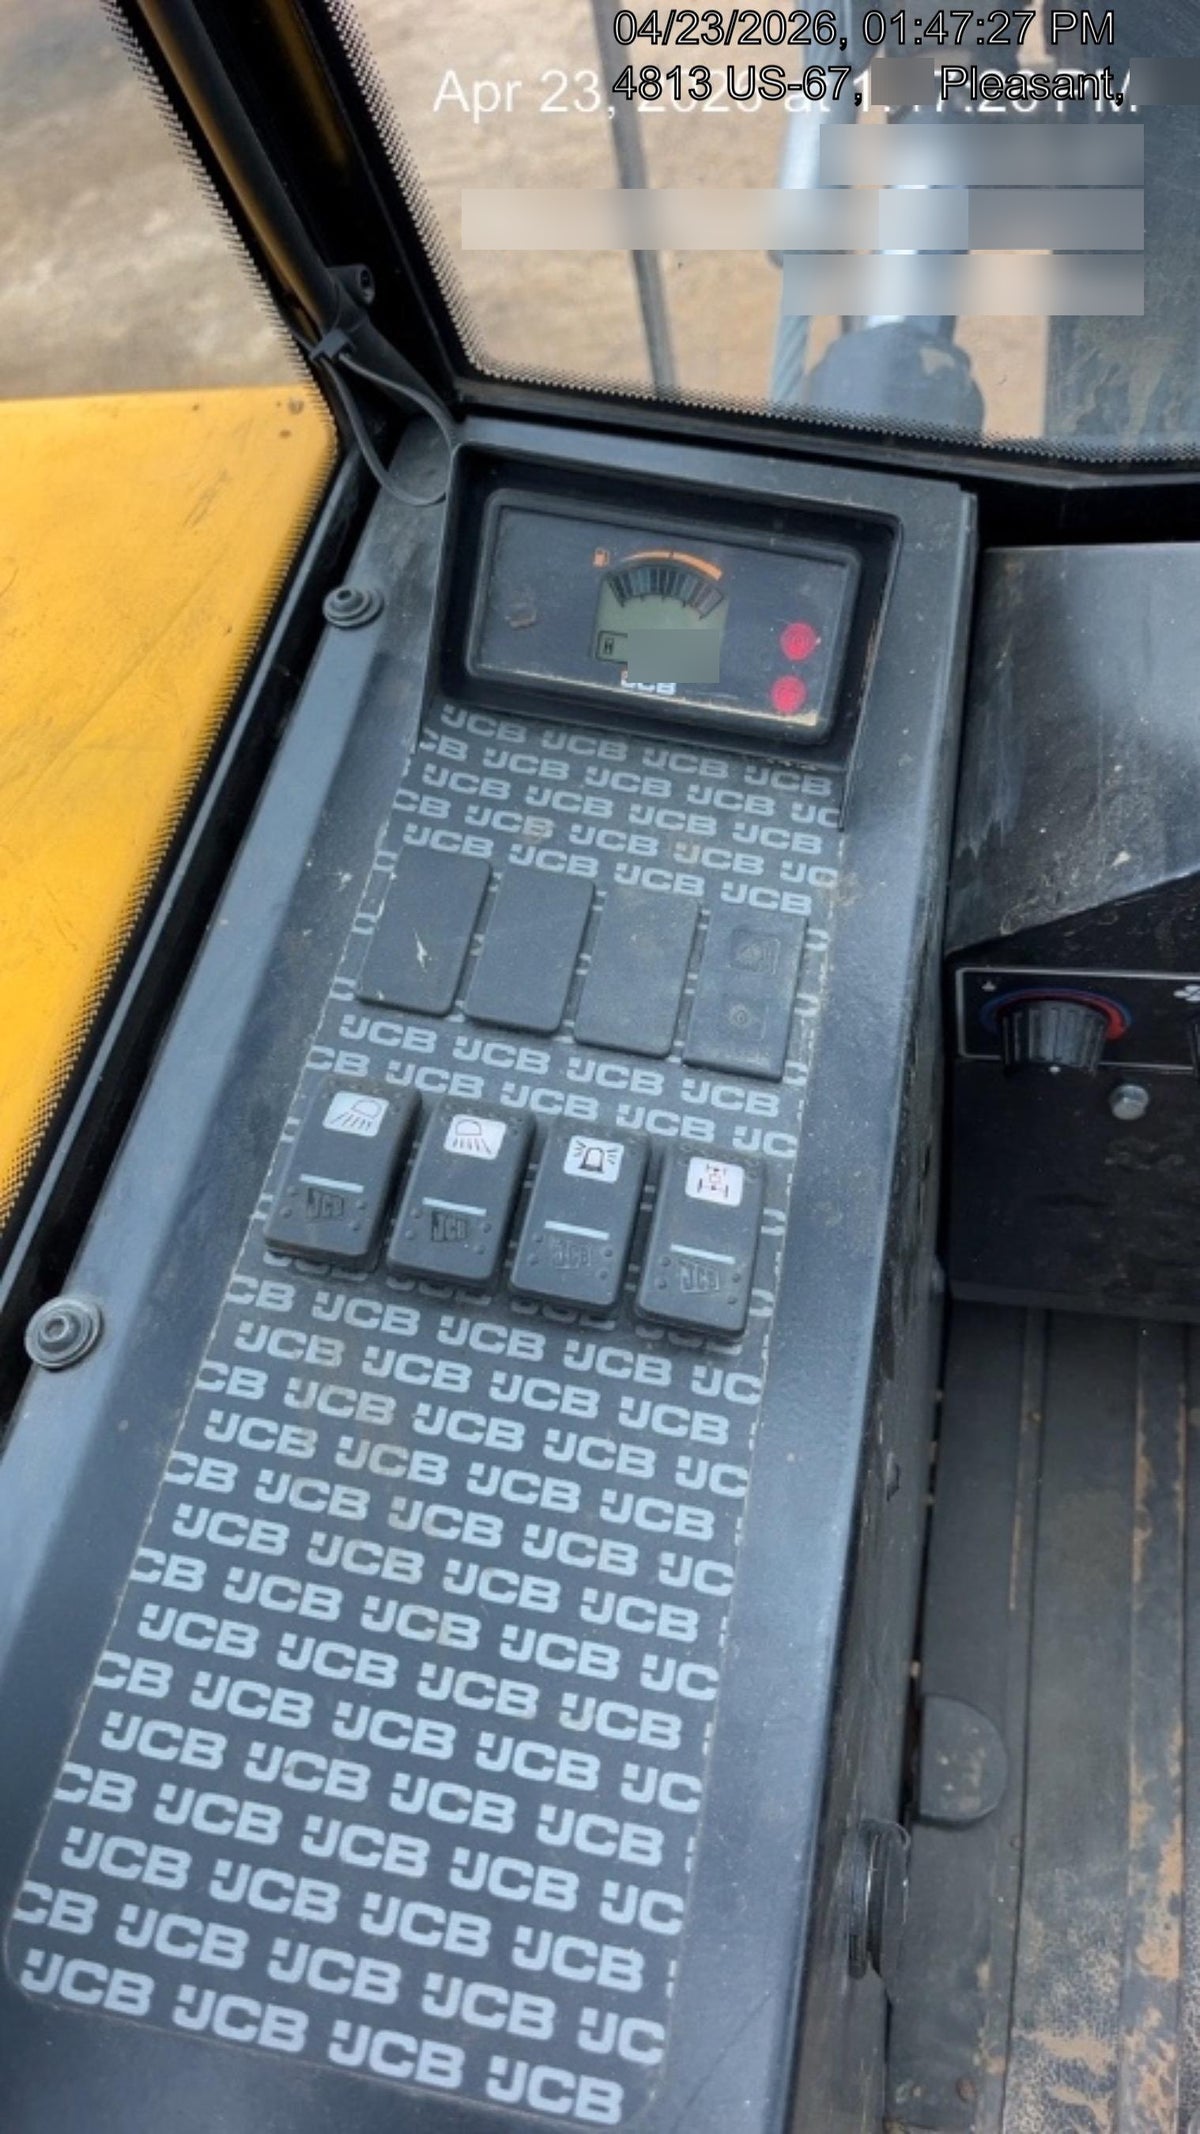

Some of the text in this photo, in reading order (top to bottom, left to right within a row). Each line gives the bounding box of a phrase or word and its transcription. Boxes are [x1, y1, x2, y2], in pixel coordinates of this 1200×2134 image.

[420, 731, 839, 827] CB JCB JCB JCB JC
[423, 764, 822, 854] JCB JCB JCB JCB
[441, 704, 832, 797] JCB JCB JCB JCB
[391, 787, 838, 890] CB JCB JCB JCB JC
[403, 823, 812, 916] JCB JCB JCB JCB
[305, 1046, 798, 1158] CB JCB JCB JCB JC
[339, 1014, 780, 1117] JCB JCB JCB JCB
[431, 1211, 468, 1242] JCB
[226, 1275, 296, 1311] CB
[312, 1290, 420, 1336] JCB
[437, 1315, 546, 1361] JCB
[563, 1339, 672, 1387] JCB
[691, 1364, 762, 1404] JC
[234, 1321, 729, 1445] JCB JCB JCB JCB
[196, 1361, 748, 1496] CB JCB JCB JCB JC
[203, 1409, 715, 1541] JCB JCB JCB JCB
[162, 1452, 736, 1596] CB JCB JCB JCB JC
[172, 1503, 699, 1642] JCB JCB JCB JCB
[129, 1548, 720, 1701] CB JCB JCB JCB JC
[137, 1603, 682, 1750] JCB JCB JCB JCB
[93, 1651, 701, 1812] CB JCB JCB JCB JC
[101, 1712, 664, 1867] JCB JCB JCB JCB
[52, 1763, 690, 1936] CB JCB JCB JCB JC
[61, 1826, 645, 1993] JCB JCB JCB JCB
[12, 1882, 666, 2067] CB JCB JCB JCB JC
[20, 1949, 624, 2125] JCB JCB JCB JCB
